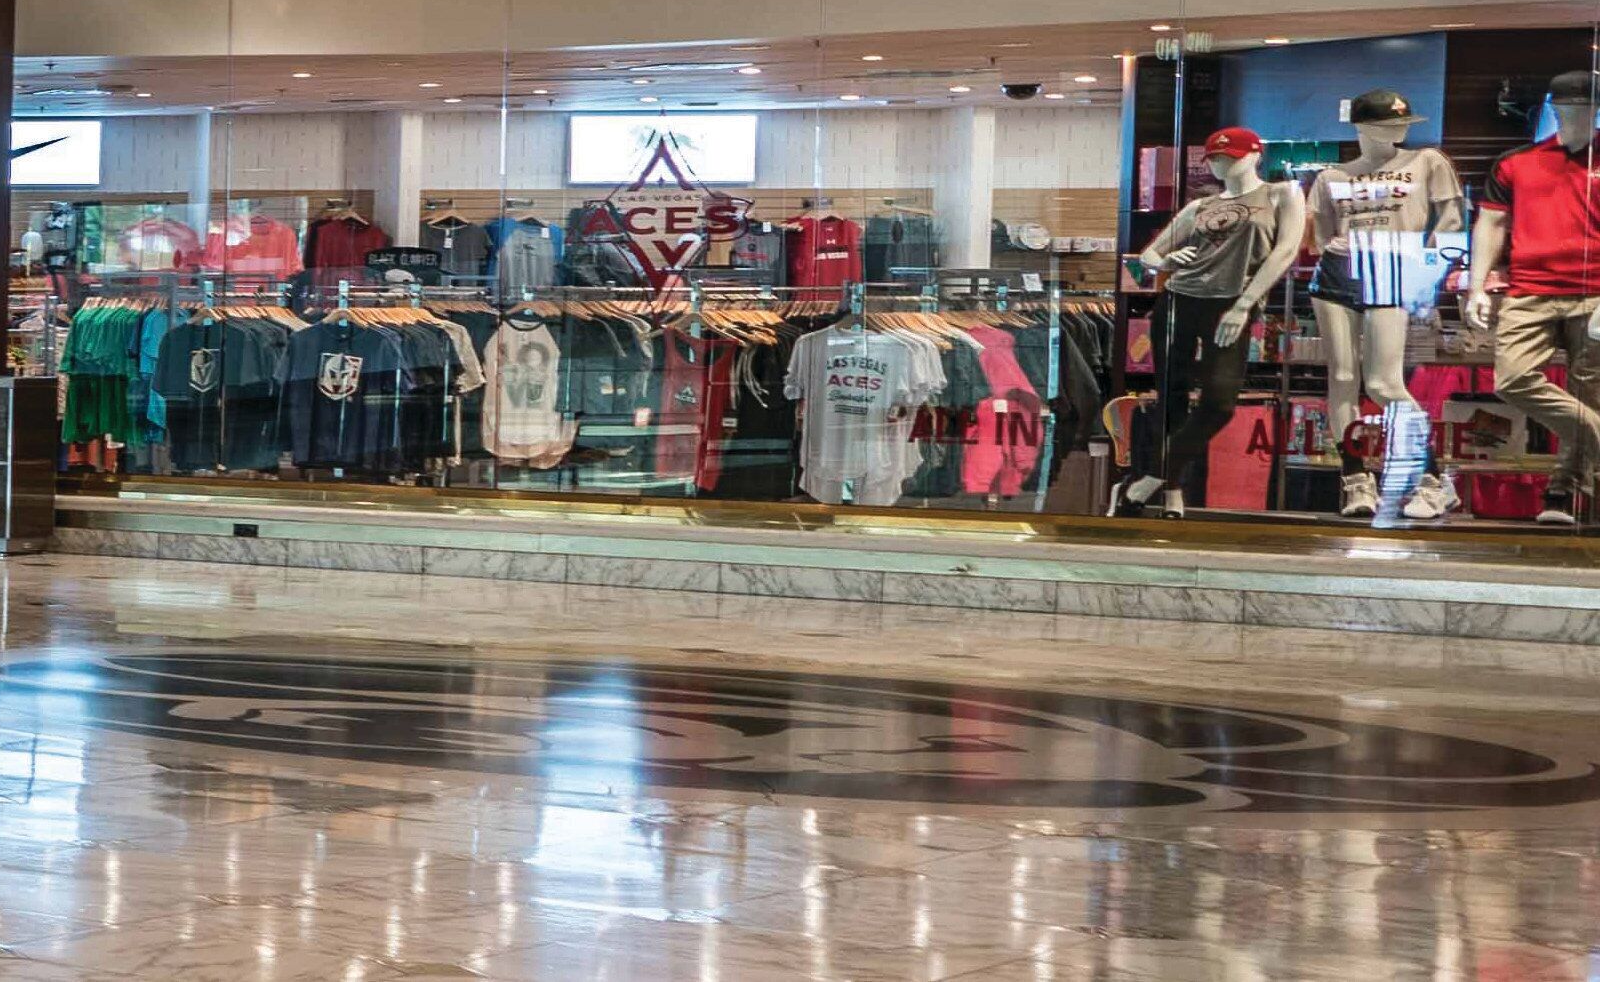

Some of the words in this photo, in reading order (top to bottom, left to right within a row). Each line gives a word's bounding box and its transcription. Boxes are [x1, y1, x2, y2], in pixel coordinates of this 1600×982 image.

[1369, 171, 1412, 183] VEGAS
[582, 206, 741, 235] ACES
[827, 357, 848, 370] LAS
[851, 356, 888, 375] VEGAS
[827, 374, 883, 391] ACES
[908, 402, 979, 445] ALL
[1246, 418, 1325, 456] ALL
